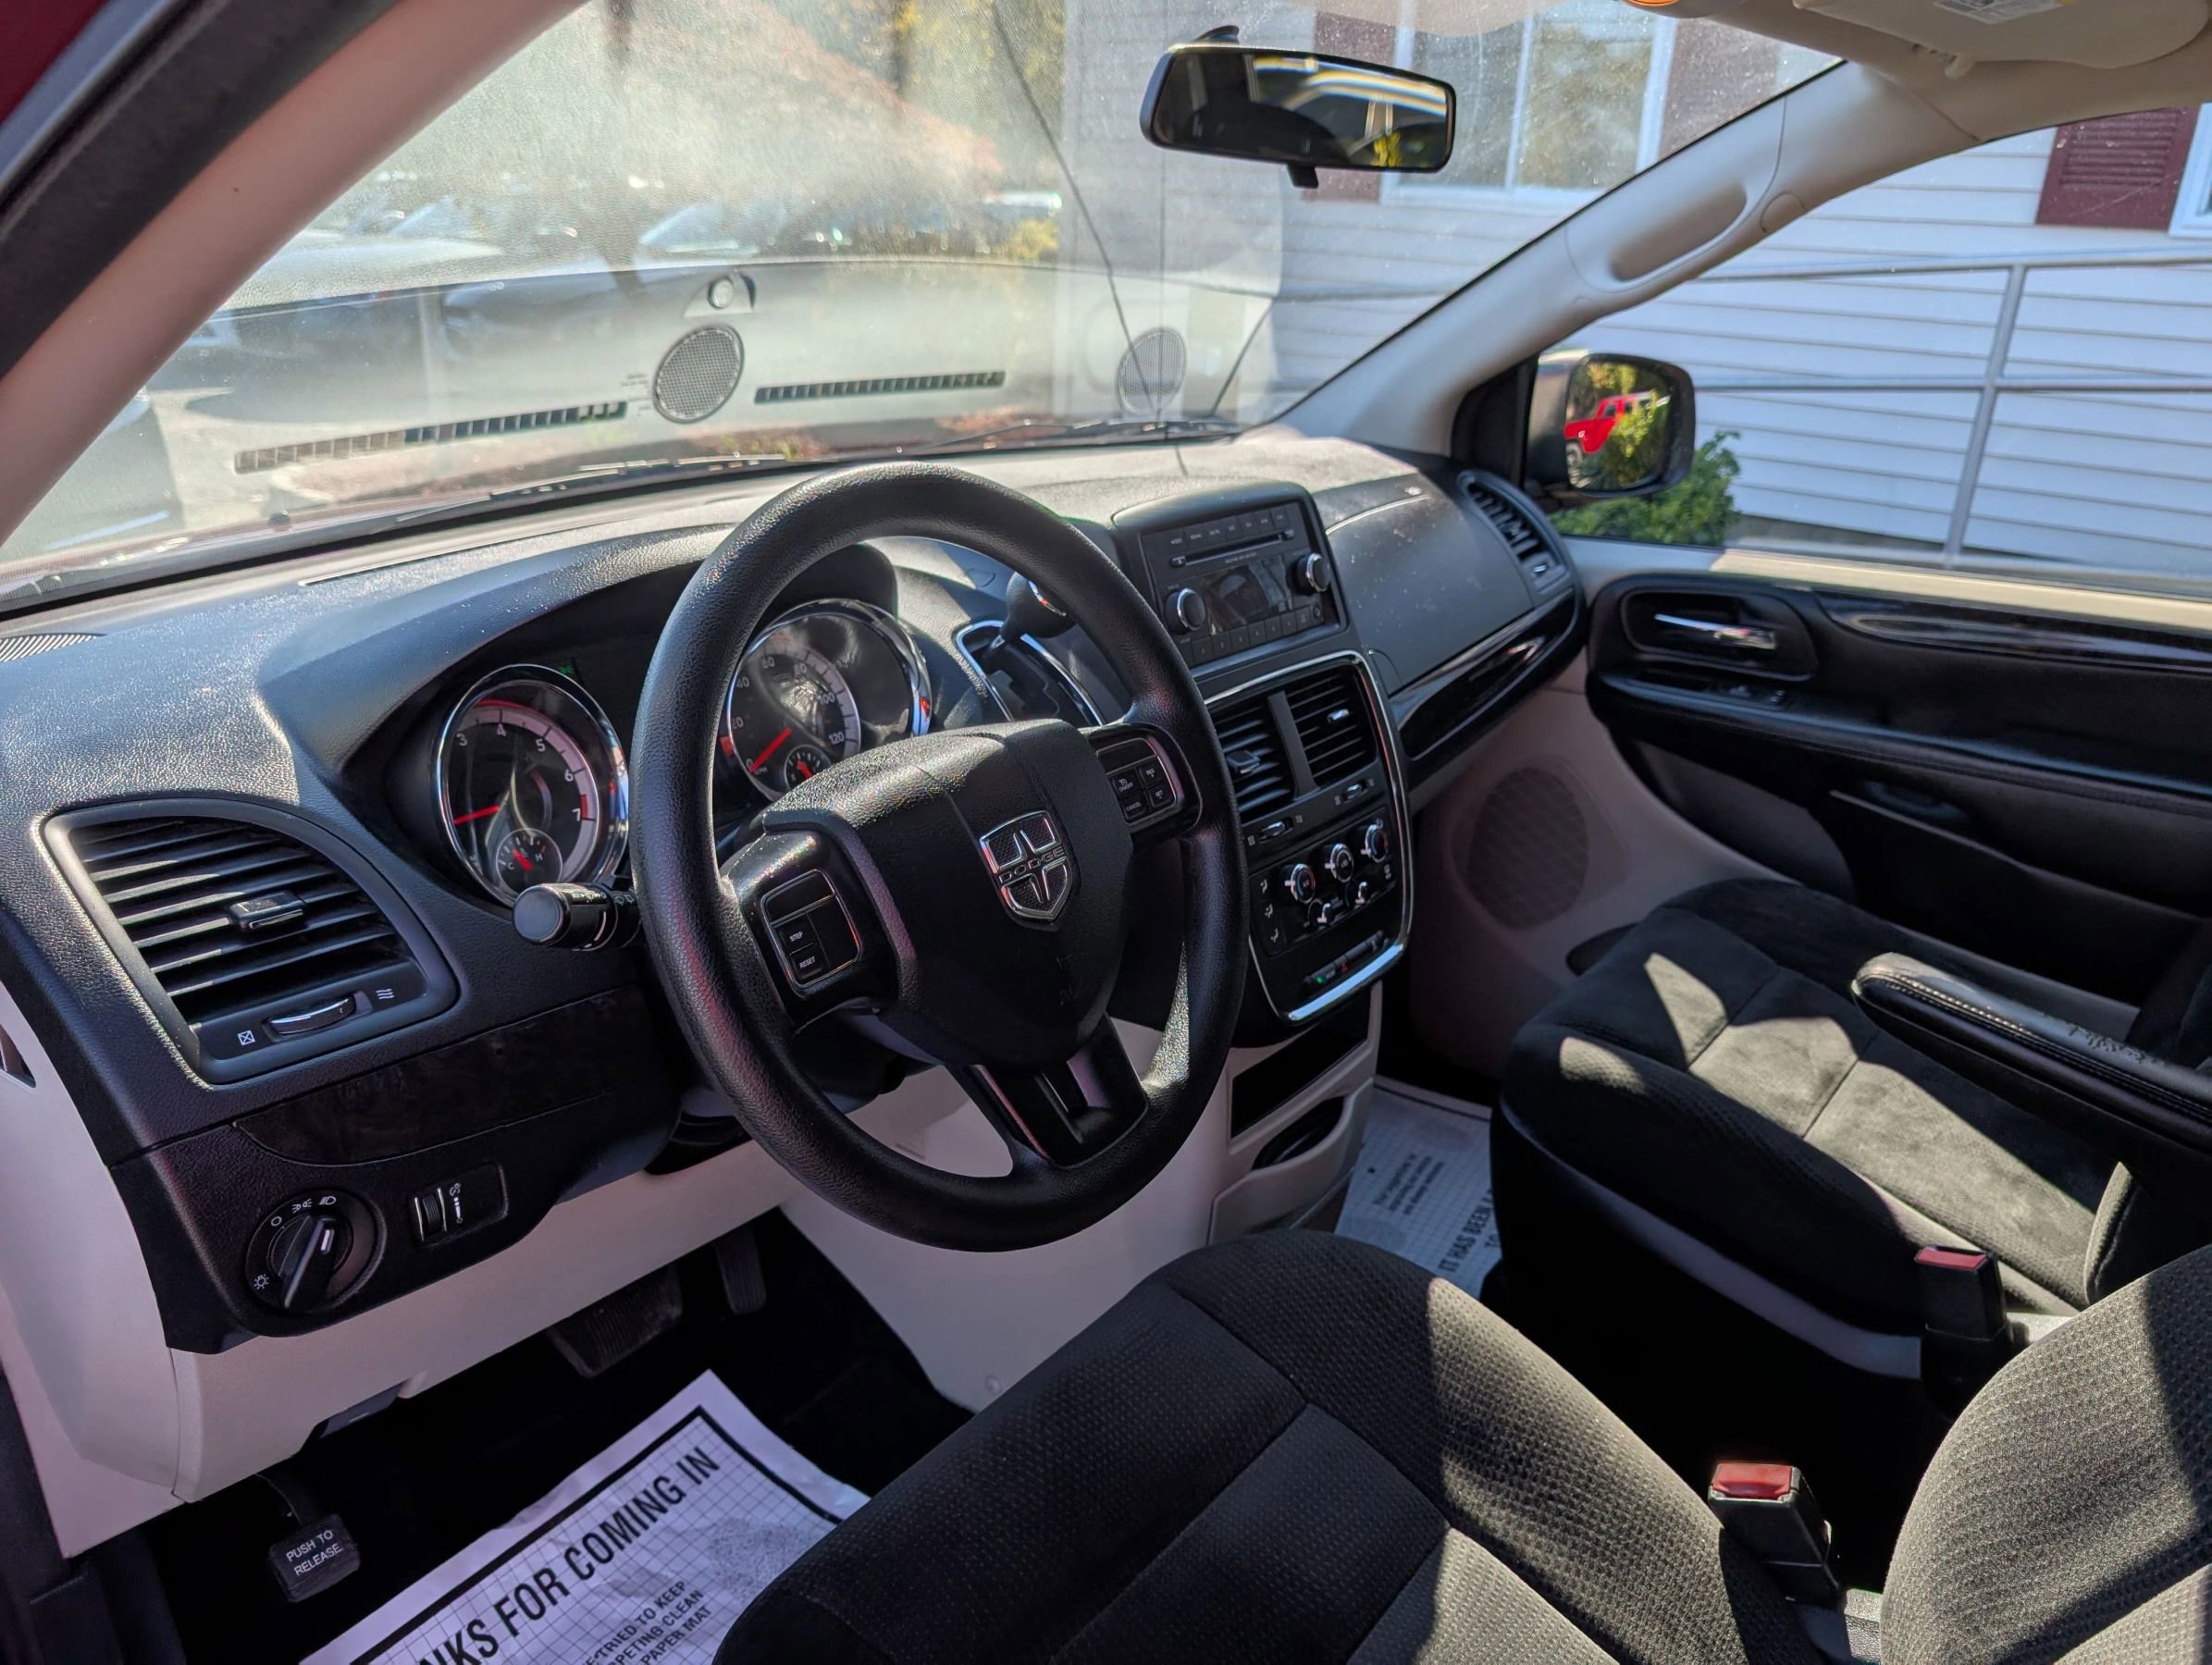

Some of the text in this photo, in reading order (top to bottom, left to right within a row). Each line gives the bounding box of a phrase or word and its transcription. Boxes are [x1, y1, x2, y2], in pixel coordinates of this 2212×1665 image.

[497, 723, 507, 737] 4
[456, 733, 468, 746] 3
[536, 738, 546, 752] 5
[829, 731, 845, 745] 120
[564, 769, 574, 782] 6
[572, 808, 581, 821] 7
[998, 846, 1065, 883] DODGE
[789, 931, 803, 942] STEP
[798, 956, 816, 969] RESET
[286, 1530, 334, 1561] PUSH TO
[493, 1568, 570, 1637] FOR
[564, 1476, 686, 1580] COMING
[676, 1447, 720, 1486] IN
[294, 1543, 343, 1575] RELEASE
[636, 1608, 656, 1625] TO
[654, 1581, 686, 1610] KEEP
[662, 1590, 704, 1626] CLEAN
[641, 1605, 711, 1665] PAPER MAT
